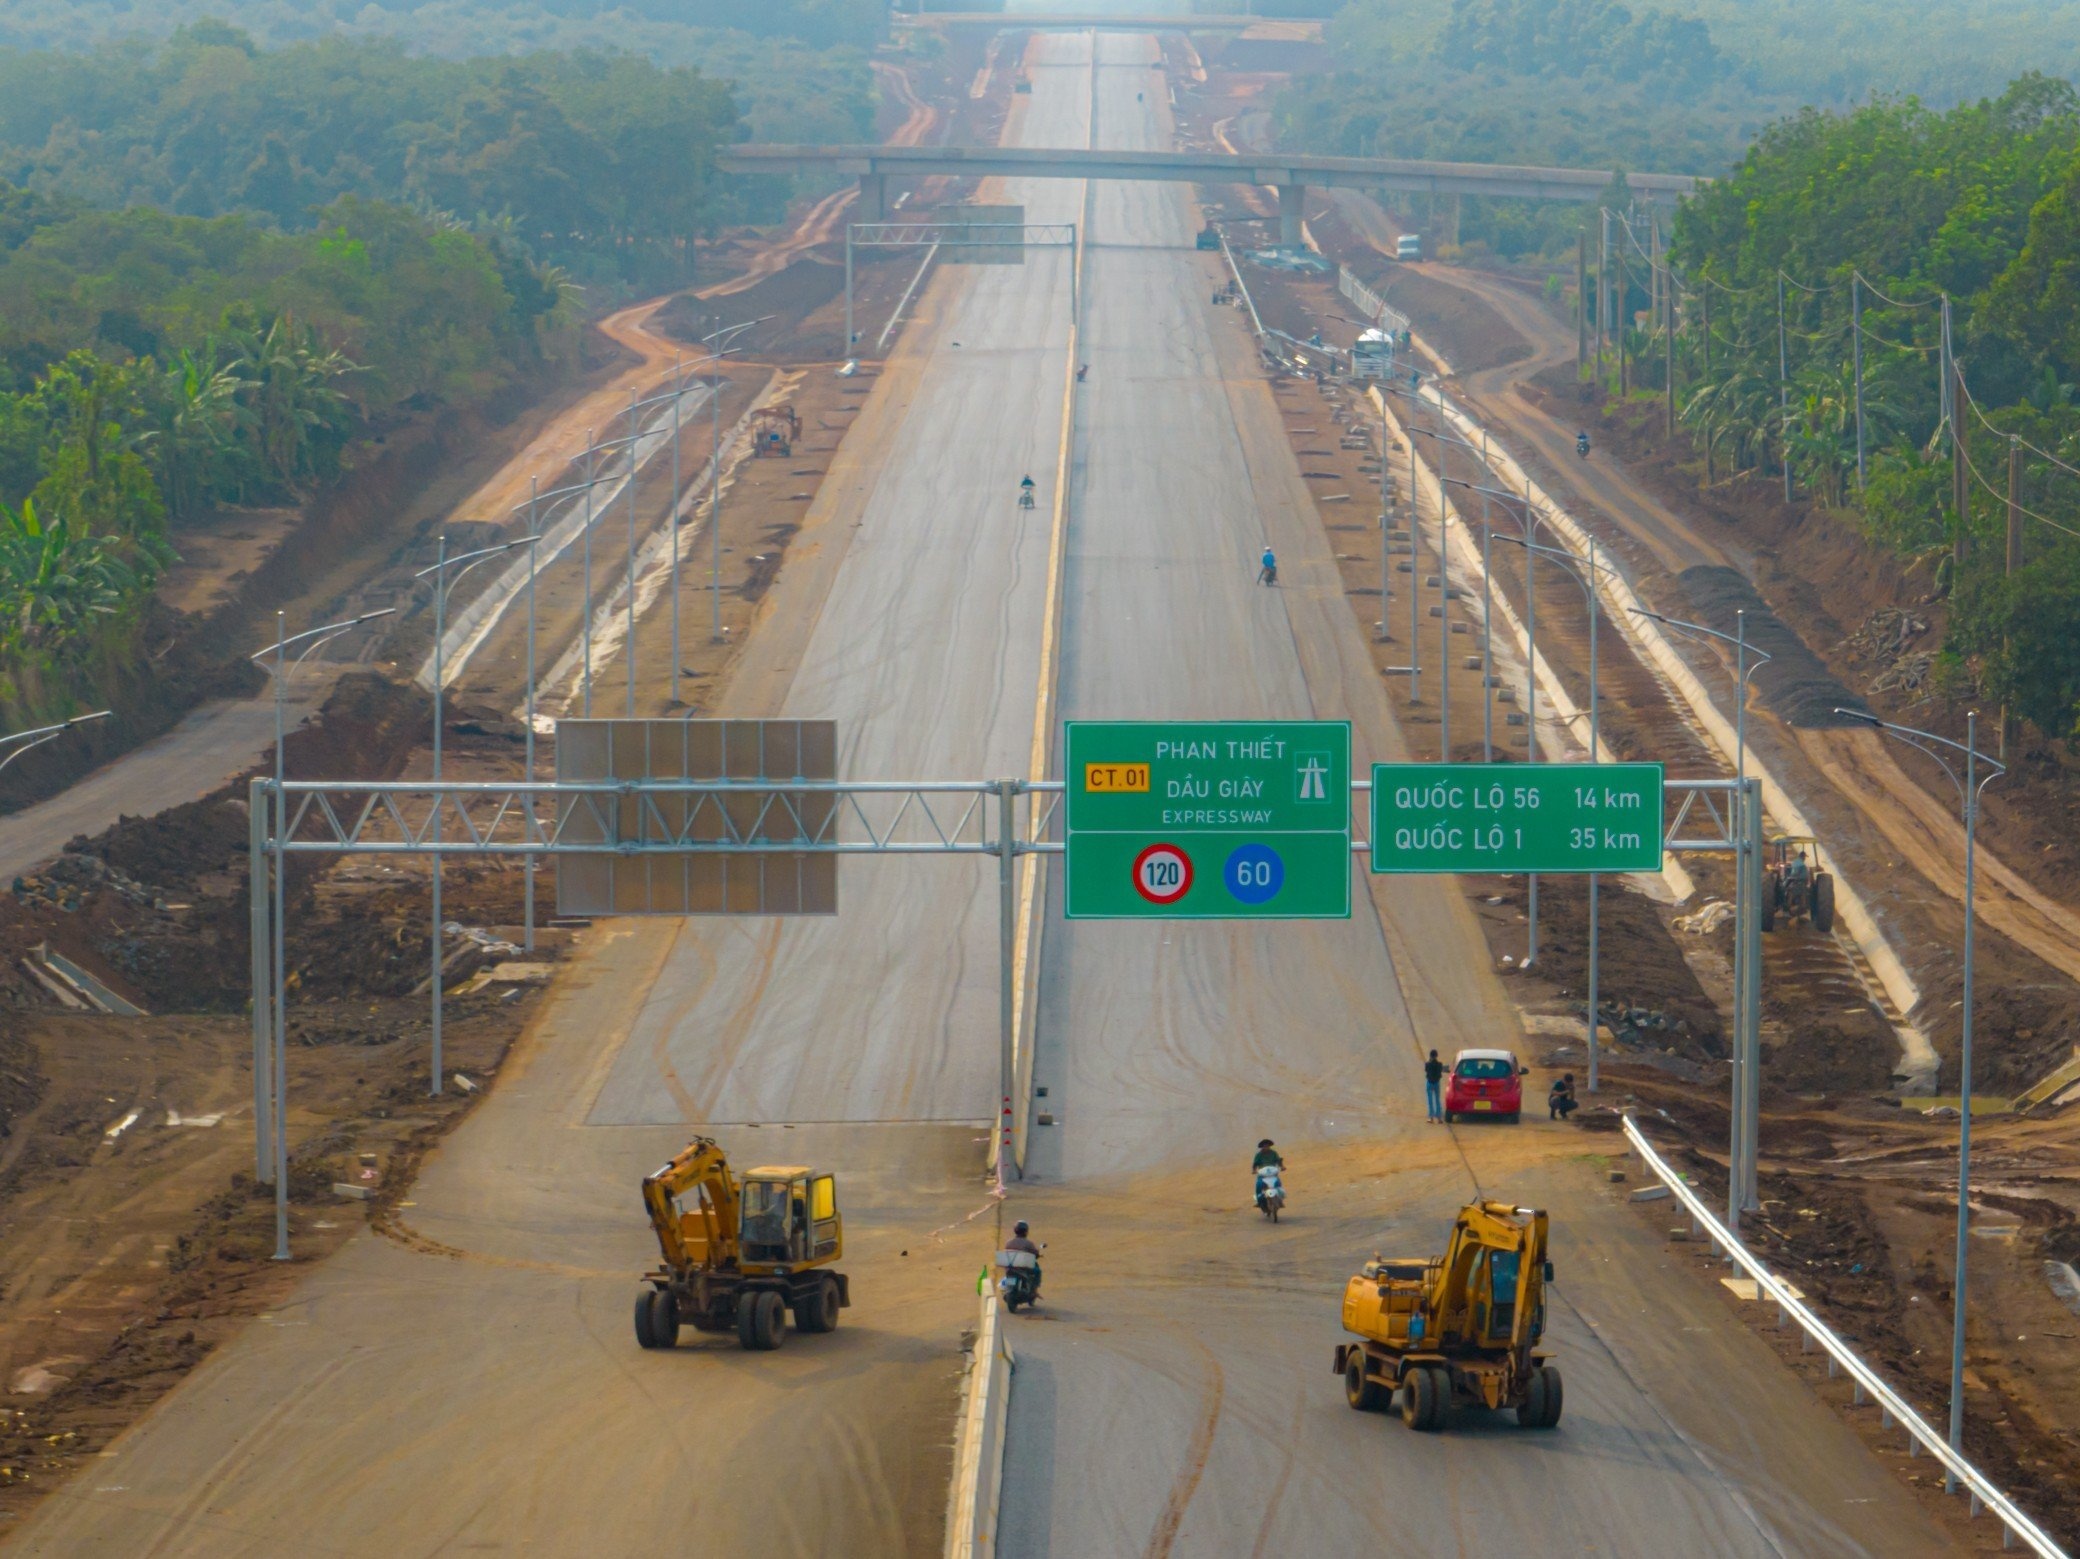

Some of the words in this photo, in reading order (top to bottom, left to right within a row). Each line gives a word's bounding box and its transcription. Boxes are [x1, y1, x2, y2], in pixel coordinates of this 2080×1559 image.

[1156, 741, 1216, 759] PHAN
[1226, 734, 1286, 759] THIẾT
[1090, 769, 1146, 787] CT.01
[1395, 780, 1464, 809] QUỐC
[1474, 783, 1504, 813] LỘ
[1514, 787, 1540, 809] 56
[1574, 787, 1597, 809] 14
[1604, 787, 1640, 809] km
[1162, 810, 1272, 824] EXPRESSWAY
[1395, 820, 1463, 850] QUỐC
[1474, 823, 1504, 853] LỘ
[1514, 828, 1521, 849] 1
[1570, 827, 1596, 849] 35
[1604, 828, 1640, 849] km
[1146, 862, 1180, 886] 120
[1237, 861, 1271, 886] 60
